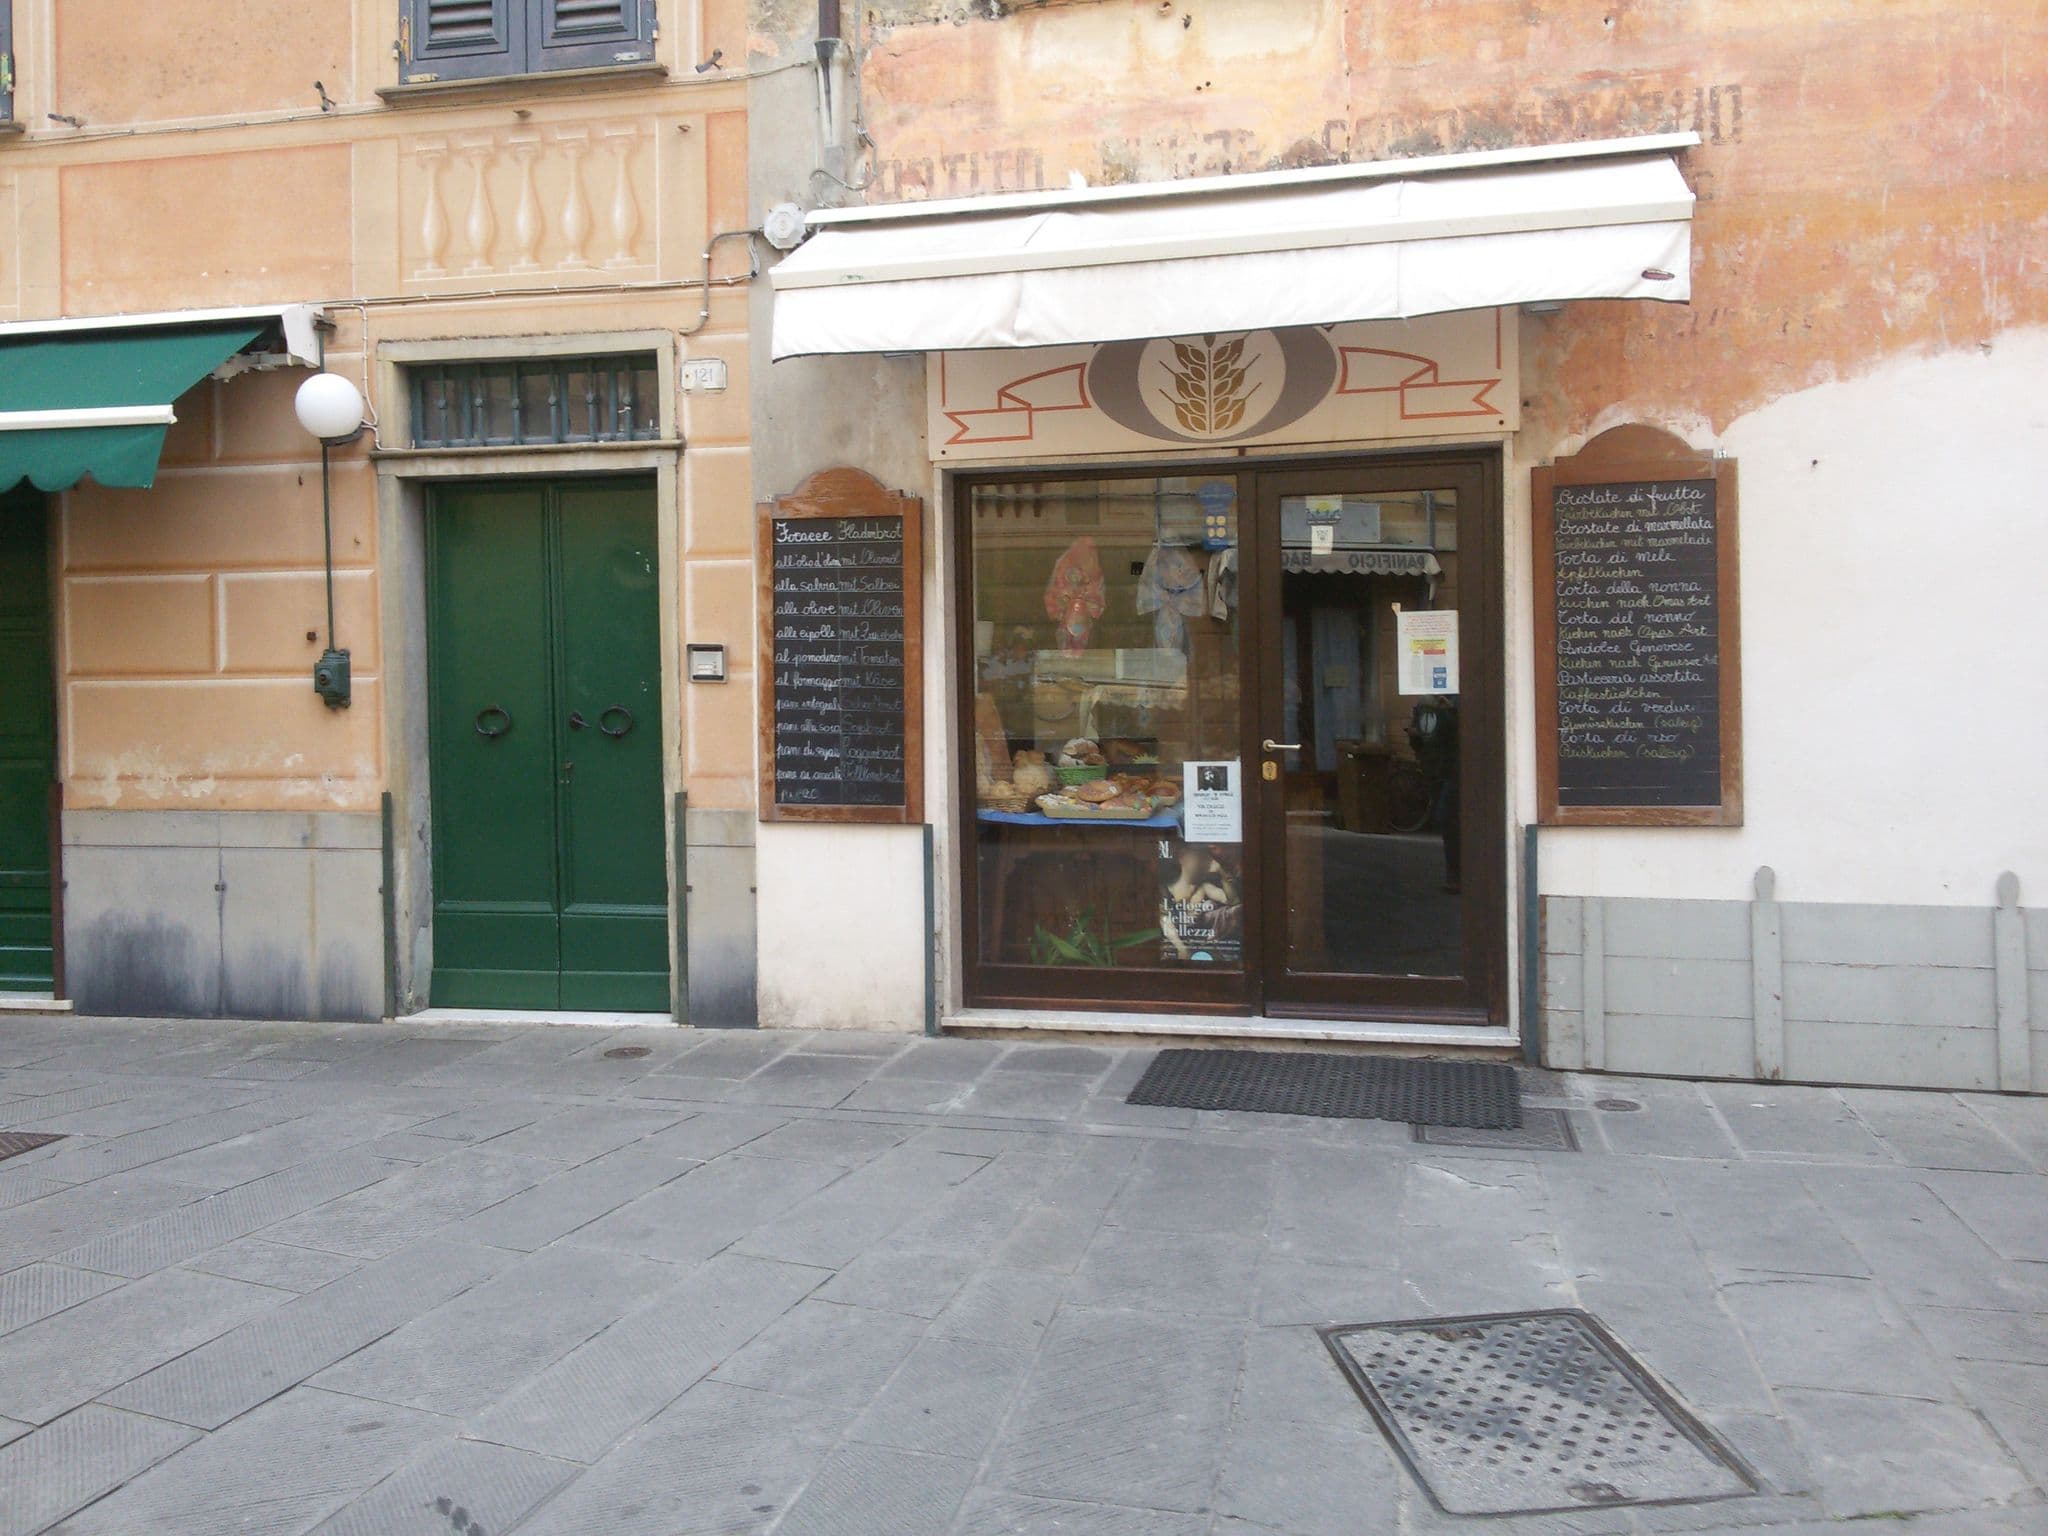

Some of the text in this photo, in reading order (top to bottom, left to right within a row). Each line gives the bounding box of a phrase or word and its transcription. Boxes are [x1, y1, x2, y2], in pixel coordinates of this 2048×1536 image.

[1626, 489, 1643, 503] di
[1646, 486, 1706, 511] frutta
[1625, 521, 1642, 533] di
[1644, 517, 1714, 533] marmellata
[1555, 549, 1677, 566] Torta di mele
[775, 578, 798, 591] alla
[800, 577, 839, 592] salvia
[1557, 581, 1702, 597] Torta della nonna
[775, 601, 798, 616] alle
[802, 600, 837, 616] olive
[1558, 610, 1697, 625] Torta del nonno
[1558, 639, 1695, 656] Pandolce Genovese
[775, 648, 790, 664] al
[775, 671, 790, 687] al
[1640, 669, 1705, 684] assortita
[1559, 701, 1601, 715] Torta
[1608, 701, 1633, 714] di
[1614, 732, 1639, 744] di
[1163, 897, 1214, 915] L'elogio
